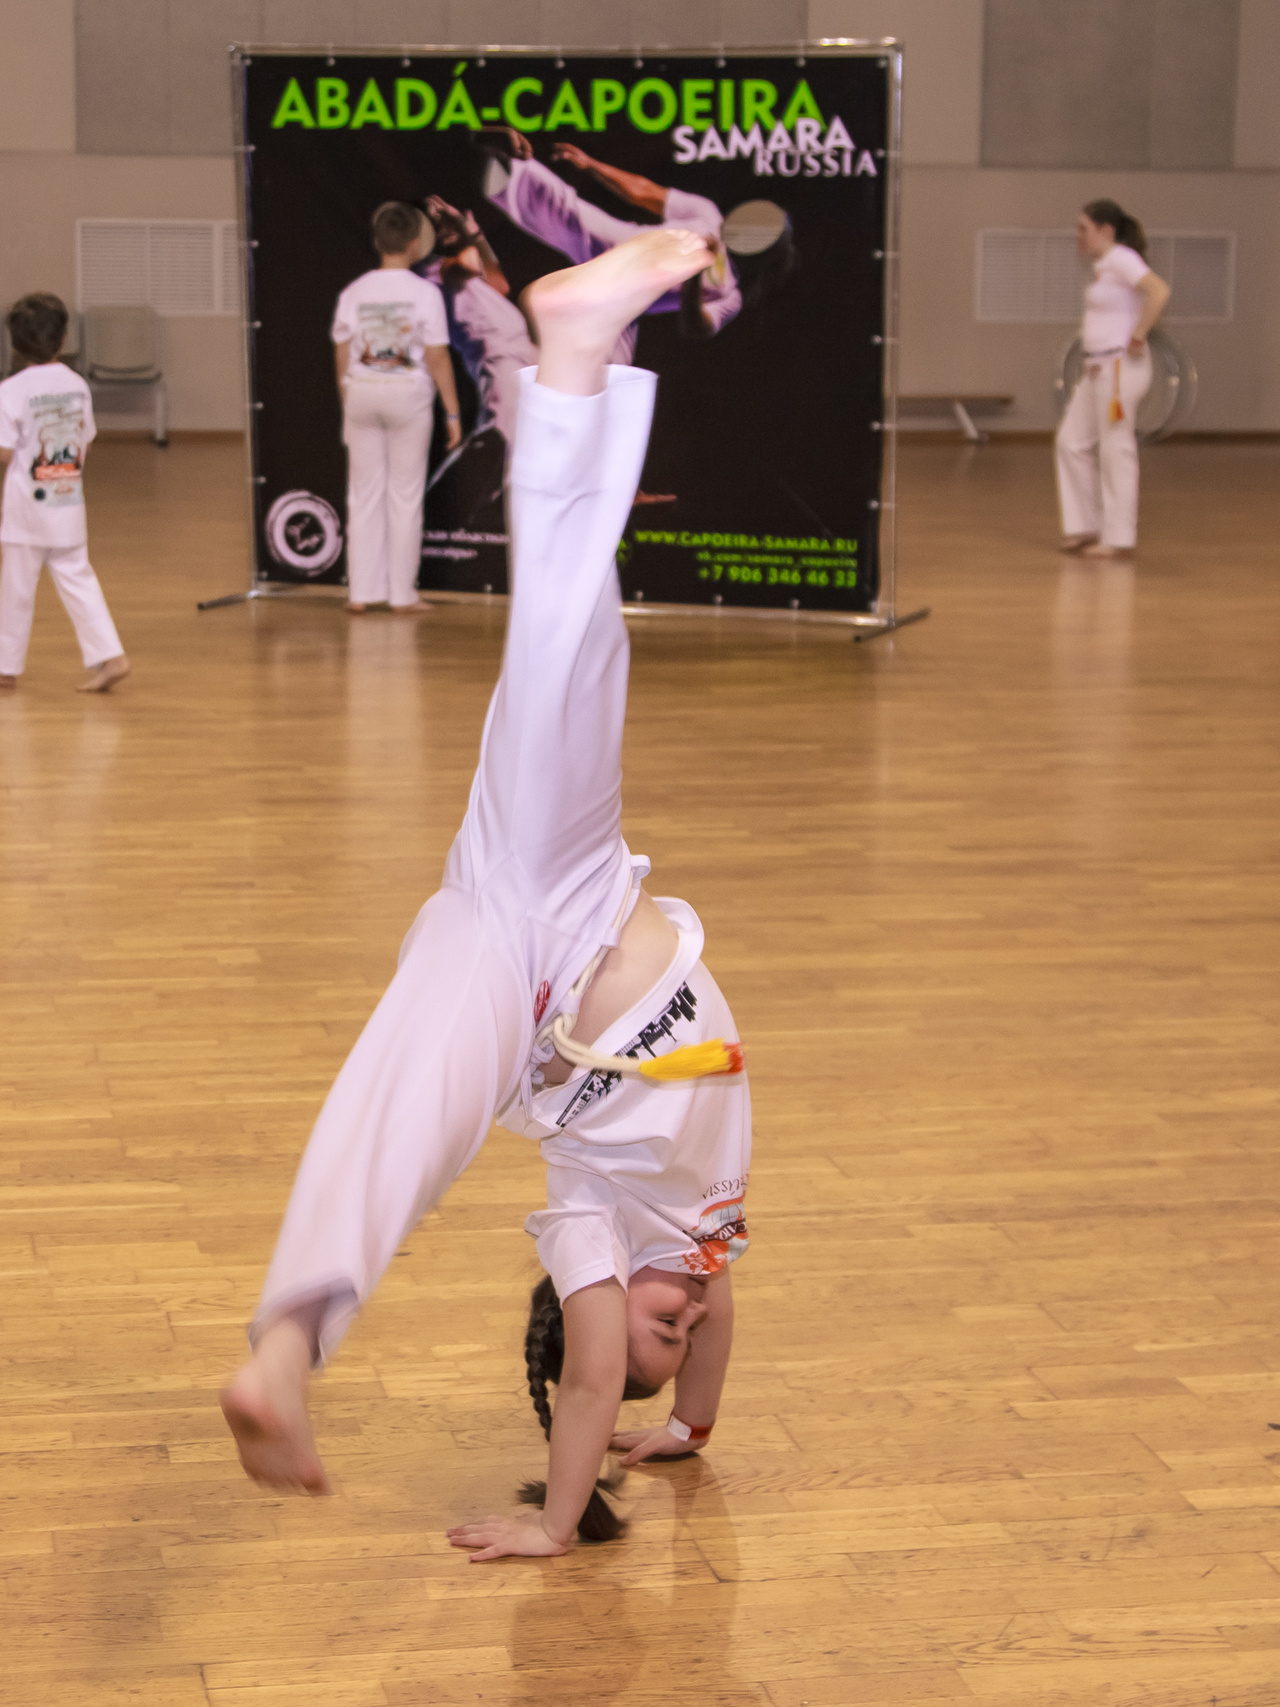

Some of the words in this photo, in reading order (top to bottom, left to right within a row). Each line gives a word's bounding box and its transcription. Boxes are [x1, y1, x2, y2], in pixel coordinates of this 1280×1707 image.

[271, 61, 827, 133] ABADÁ-CAPOEIRA
[673, 114, 856, 164] SAMARA
[754, 149, 878, 177] RUSSIA
[728, 565, 763, 584] 906
[807, 569, 829, 587] 46
